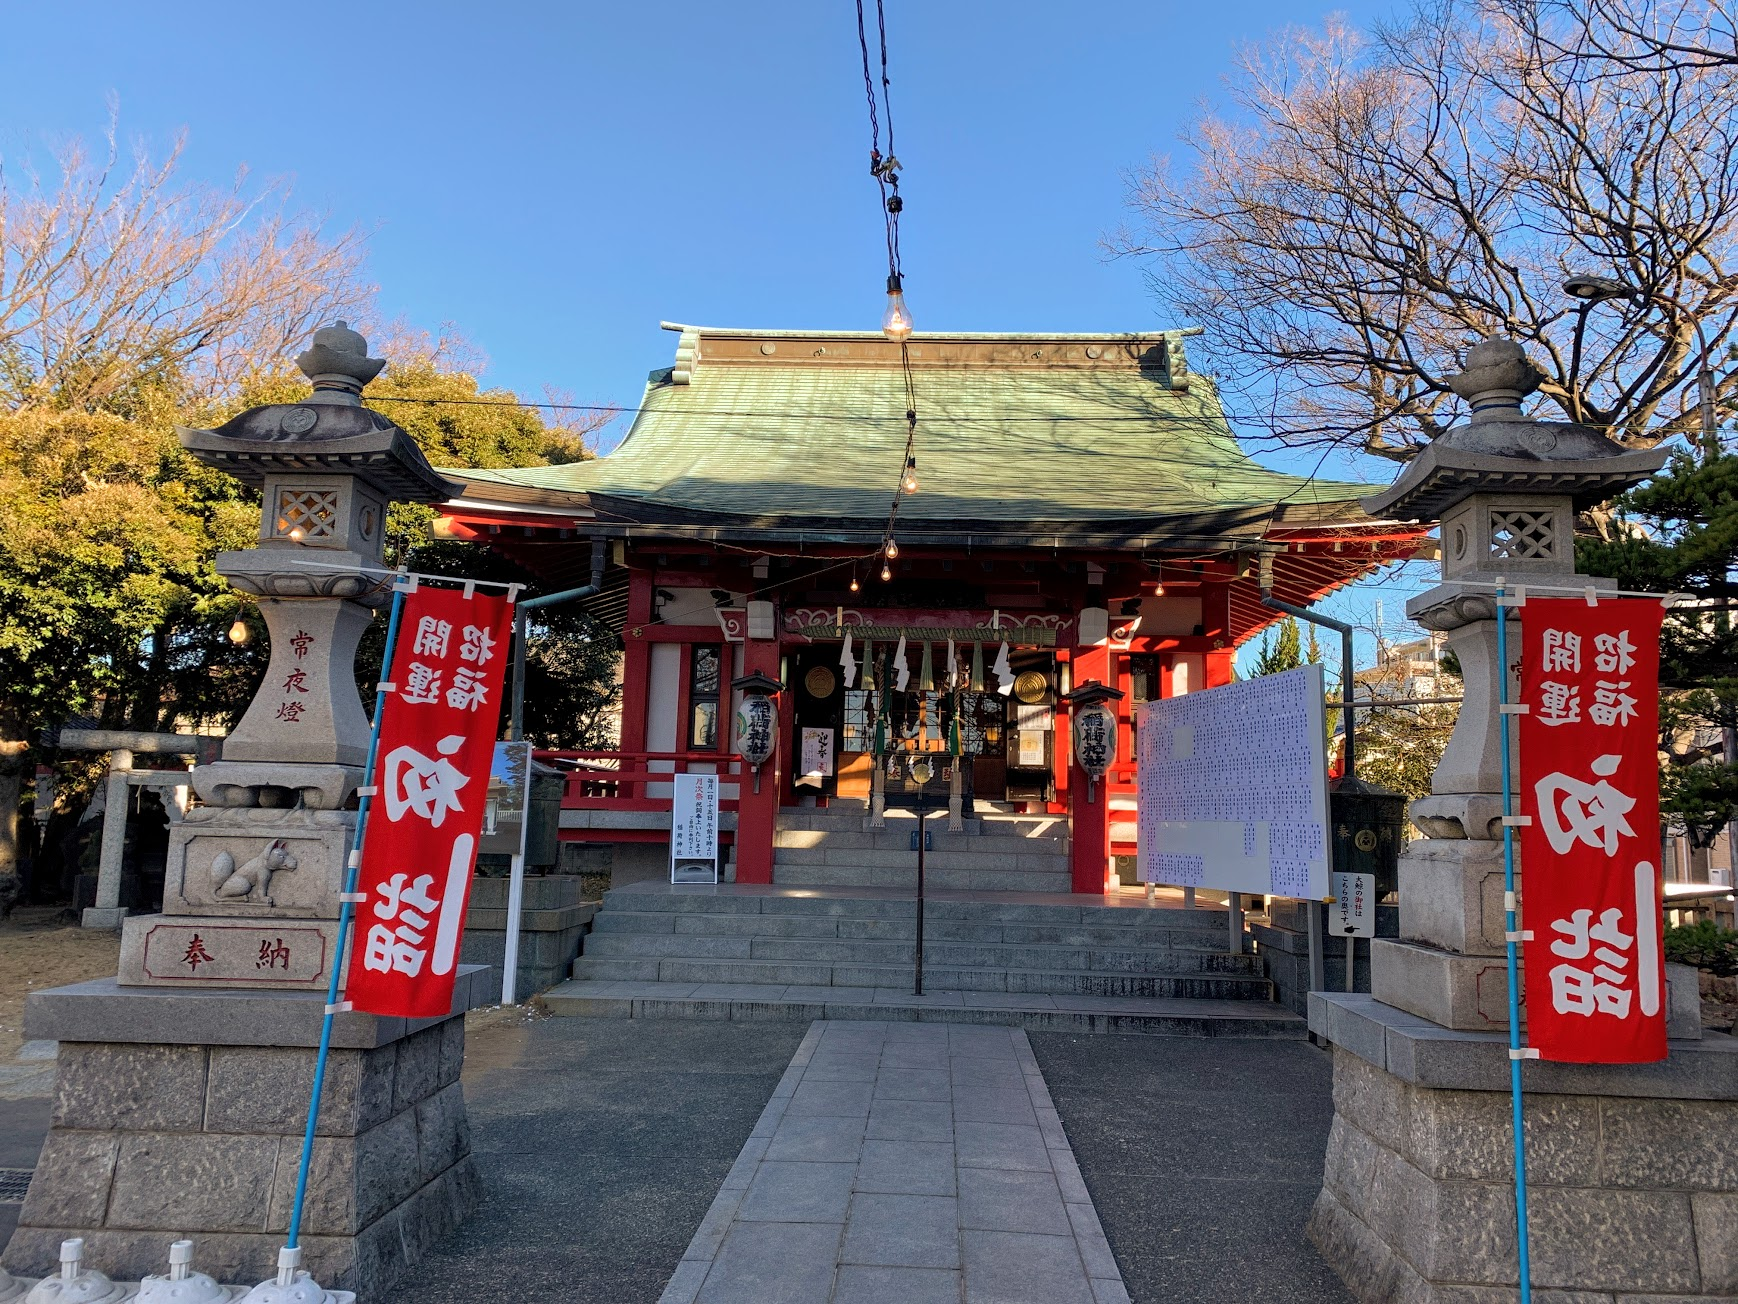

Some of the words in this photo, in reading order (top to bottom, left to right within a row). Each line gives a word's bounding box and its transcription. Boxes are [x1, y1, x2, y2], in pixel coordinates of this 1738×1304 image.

[275, 630, 314, 722] 常夜燈
[181, 934, 290, 972] 奉納
